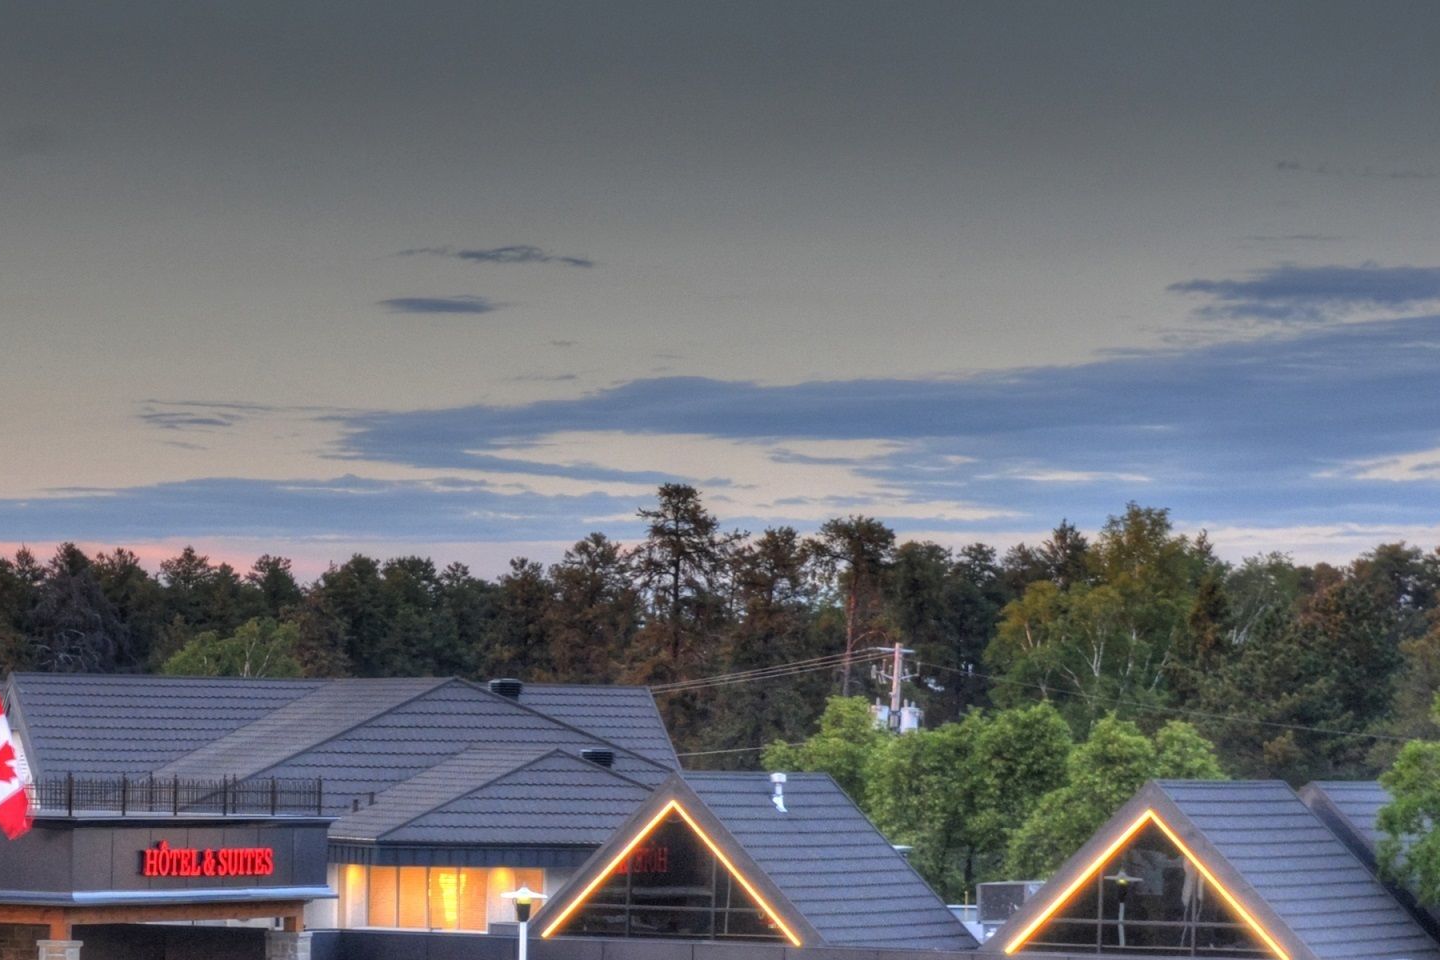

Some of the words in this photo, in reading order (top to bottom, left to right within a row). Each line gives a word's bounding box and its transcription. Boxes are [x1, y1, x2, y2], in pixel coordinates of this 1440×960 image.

[144, 839, 201, 877] HÔTEL
[203, 848, 217, 876] &
[217, 847, 274, 876] SUITES
